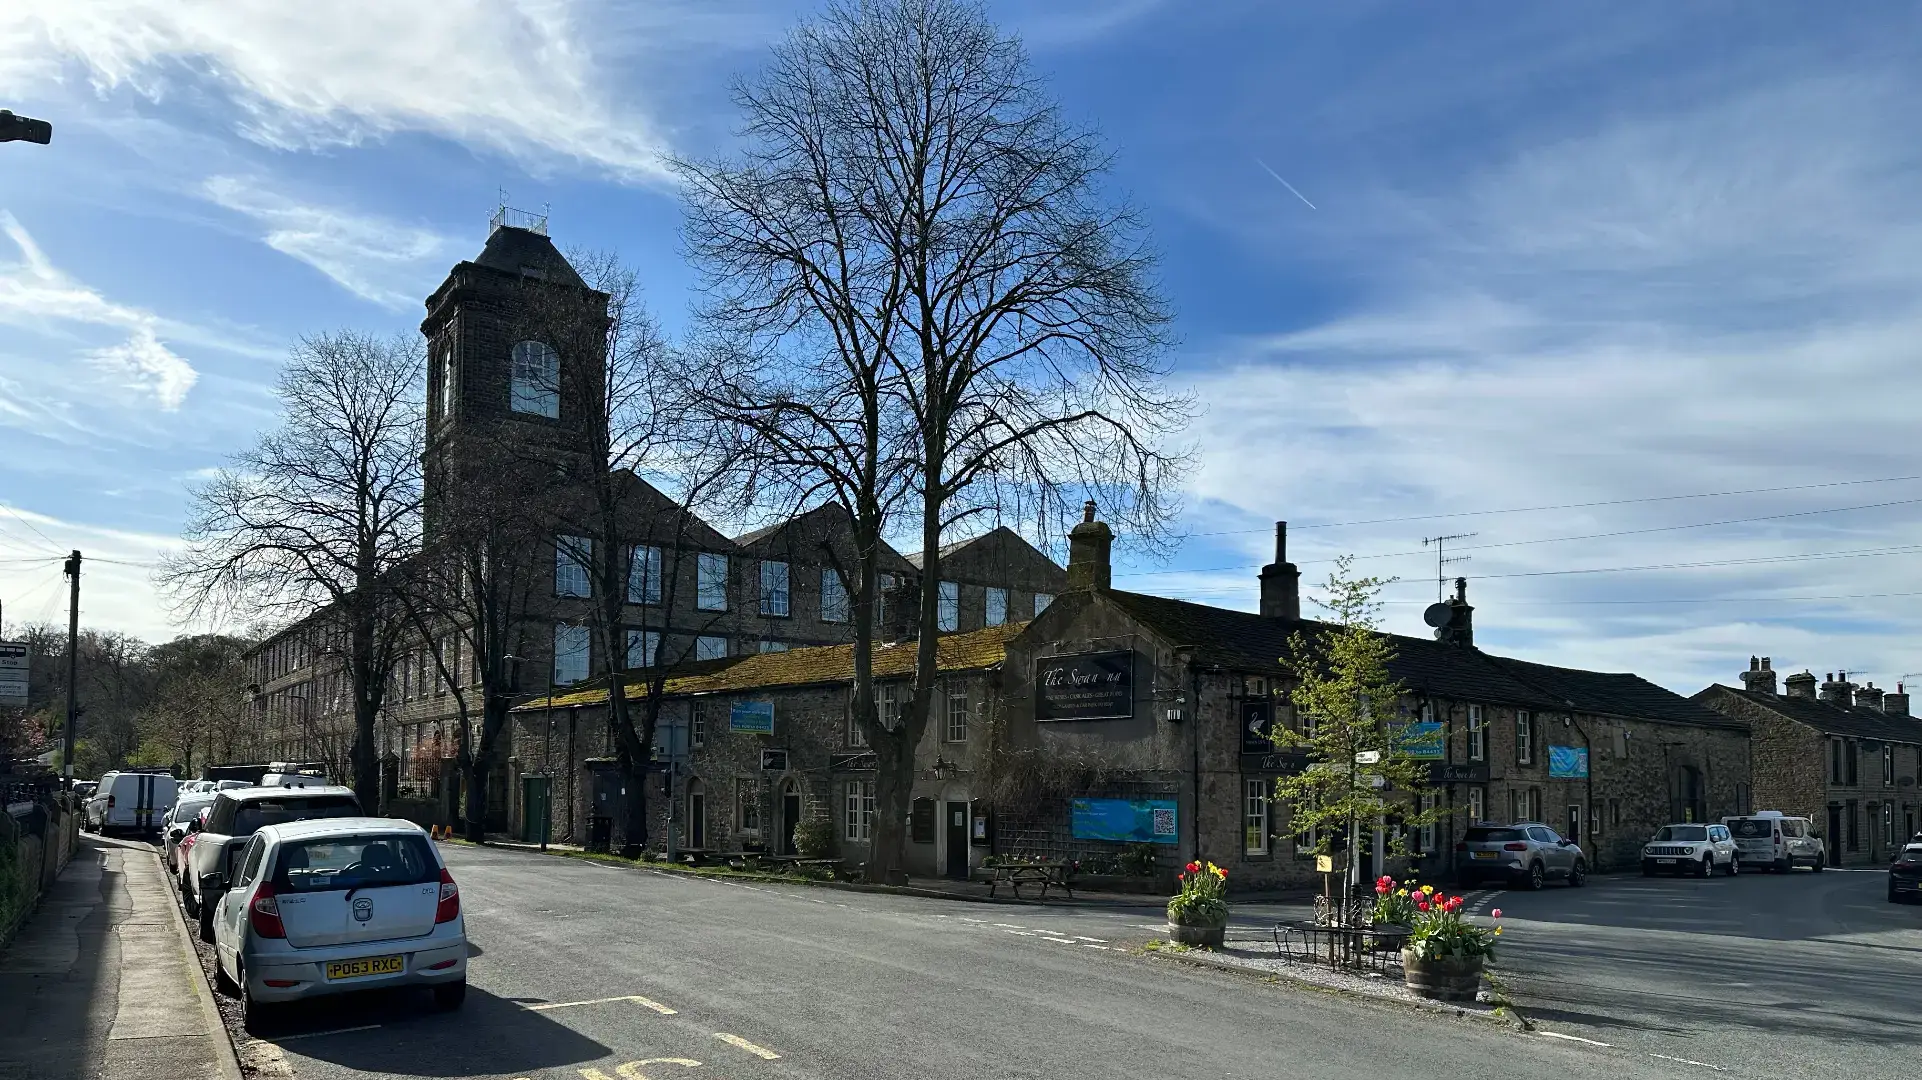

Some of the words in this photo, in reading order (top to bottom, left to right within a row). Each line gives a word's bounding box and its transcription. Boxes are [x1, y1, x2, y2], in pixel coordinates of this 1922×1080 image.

[1043, 667, 1064, 686] The
[1067, 668, 1099, 685] Swan
[333, 961, 369, 976] PO63
[372, 958, 399, 972] RXC
